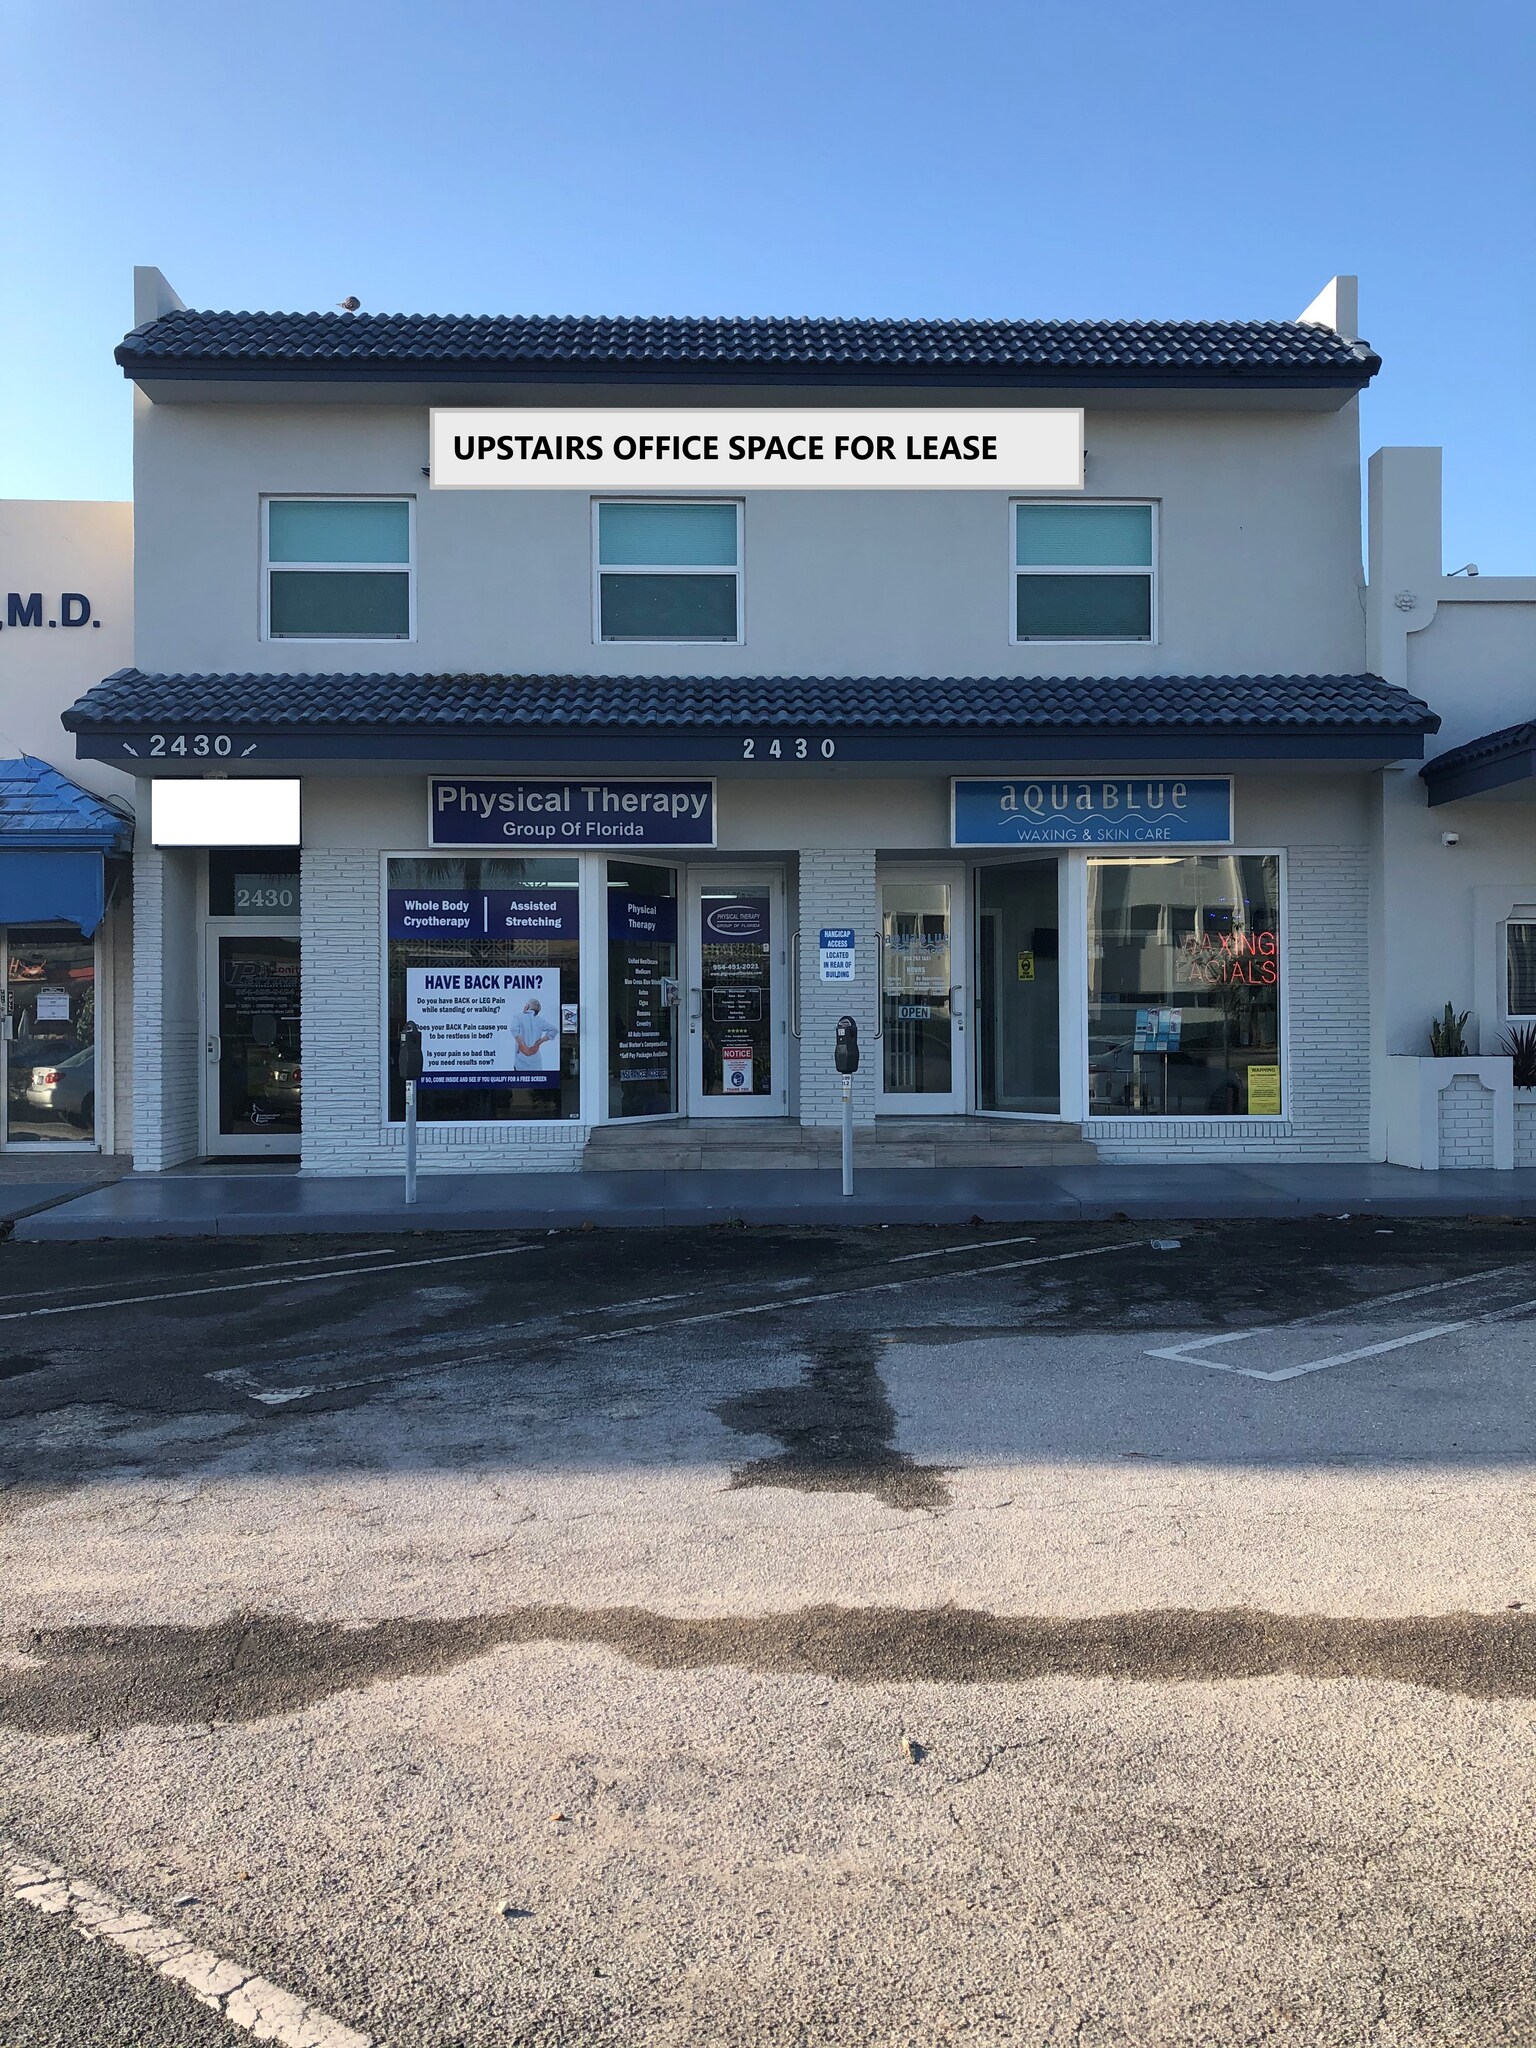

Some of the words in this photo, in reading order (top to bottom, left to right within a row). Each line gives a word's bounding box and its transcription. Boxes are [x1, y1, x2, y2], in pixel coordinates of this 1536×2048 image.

[150, 734, 232, 757] 2430
[743, 738, 835, 759] 2430
[437, 786, 570, 818] Physical
[581, 786, 708, 819] Therapy
[502, 821, 556, 838] Group
[561, 821, 581, 835] Of
[586, 820, 645, 836] Florida
[1017, 828, 1077, 841] WAXING
[1082, 828, 1092, 840] &
[1098, 828, 1130, 840] SKIN
[1135, 827, 1171, 840] CARE
[237, 889, 293, 907] 2430
[404, 900, 439, 911] Whole
[442, 900, 469, 912] Body
[510, 901, 556, 911] Assisted
[627, 903, 657, 915] Physical
[403, 916, 470, 928] Cryotherapy
[505, 916, 562, 928] Stretching
[628, 918, 656, 931] Therapy
[824, 930, 851, 938] HANDICAP
[827, 940, 848, 948] ACCESS
[425, 975, 461, 990] HAVE
[464, 975, 501, 990] BACK
[504, 975, 543, 990] PAIN?
[439, 1006, 465, 1014] standing
[474, 1006, 501, 1014] walking?
[901, 1007, 928, 1018] OPEN
[448, 1050, 461, 1058] pain
[724, 1050, 751, 1058] NOTICE
